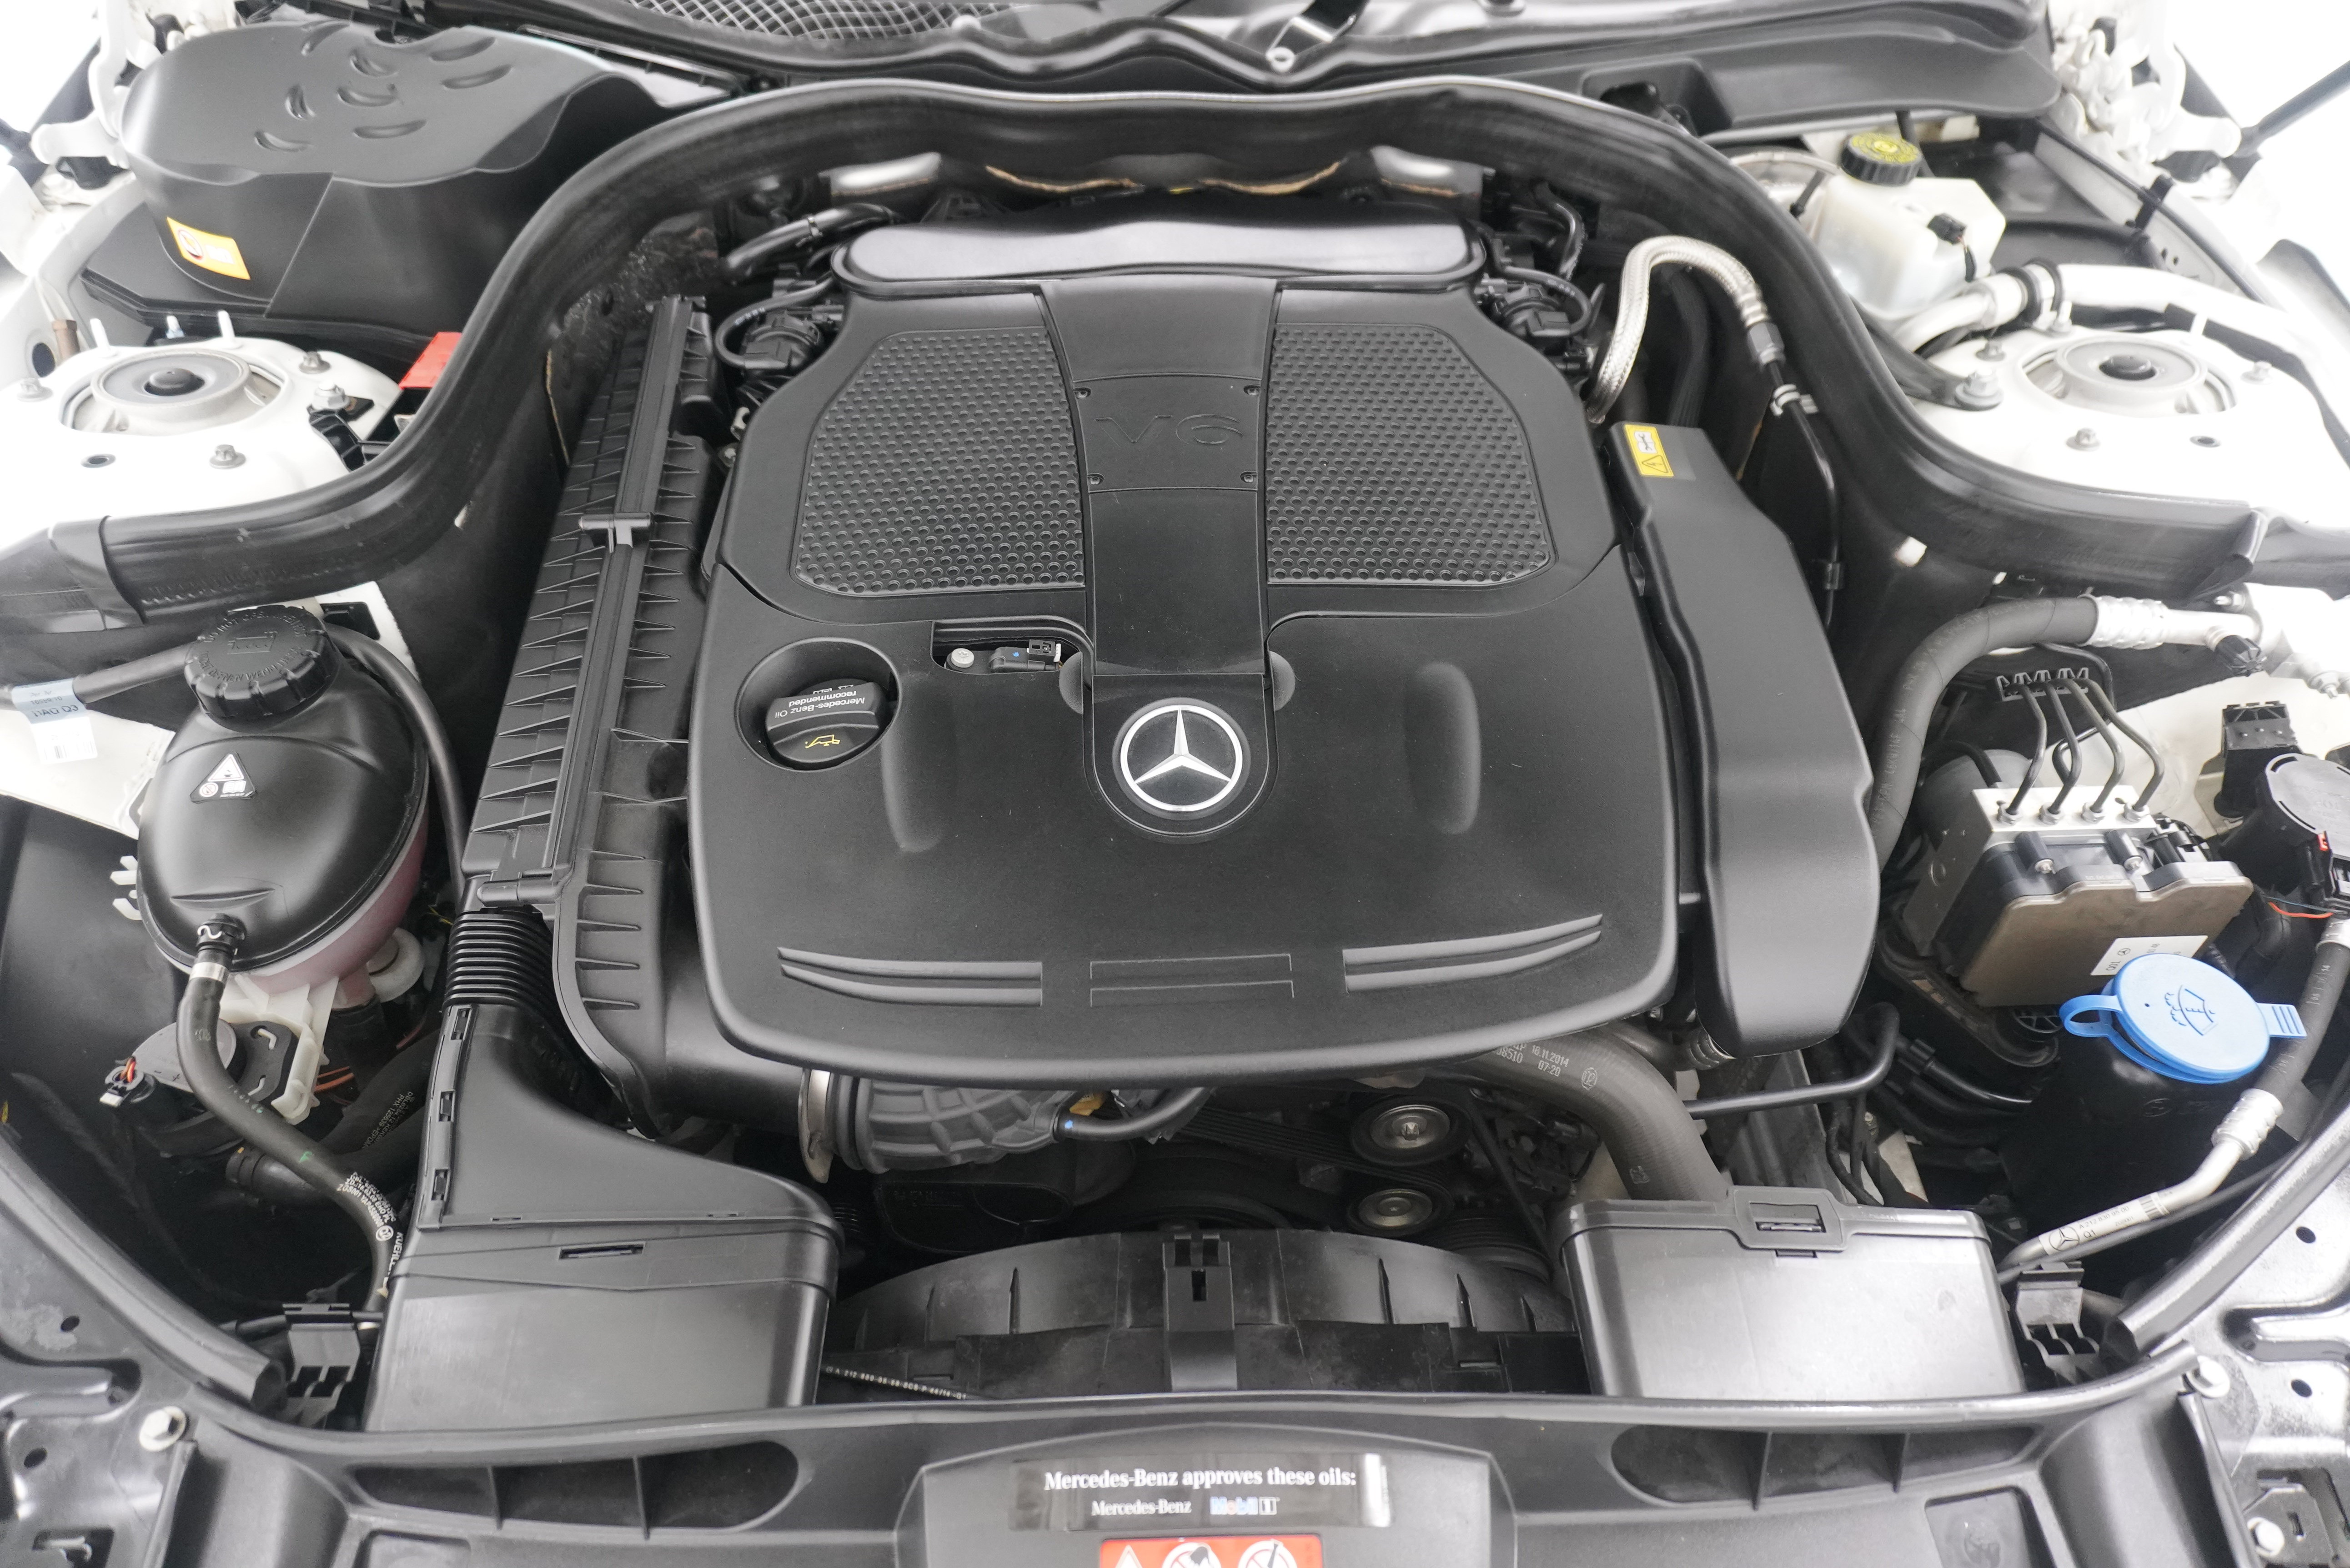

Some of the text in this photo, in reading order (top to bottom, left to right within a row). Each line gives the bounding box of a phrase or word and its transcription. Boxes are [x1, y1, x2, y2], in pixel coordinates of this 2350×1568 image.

[1096, 414, 1244, 446] V6
[774, 697, 865, 719] Mercedes-Benz Oil
[788, 690, 857, 708] recommended
[2083, 1229, 2097, 1239] Q1
[1044, 1467, 1356, 1491] Mercedes-Benz approves these oils:
[1091, 1498, 1192, 1516] Mercedes-Benz
